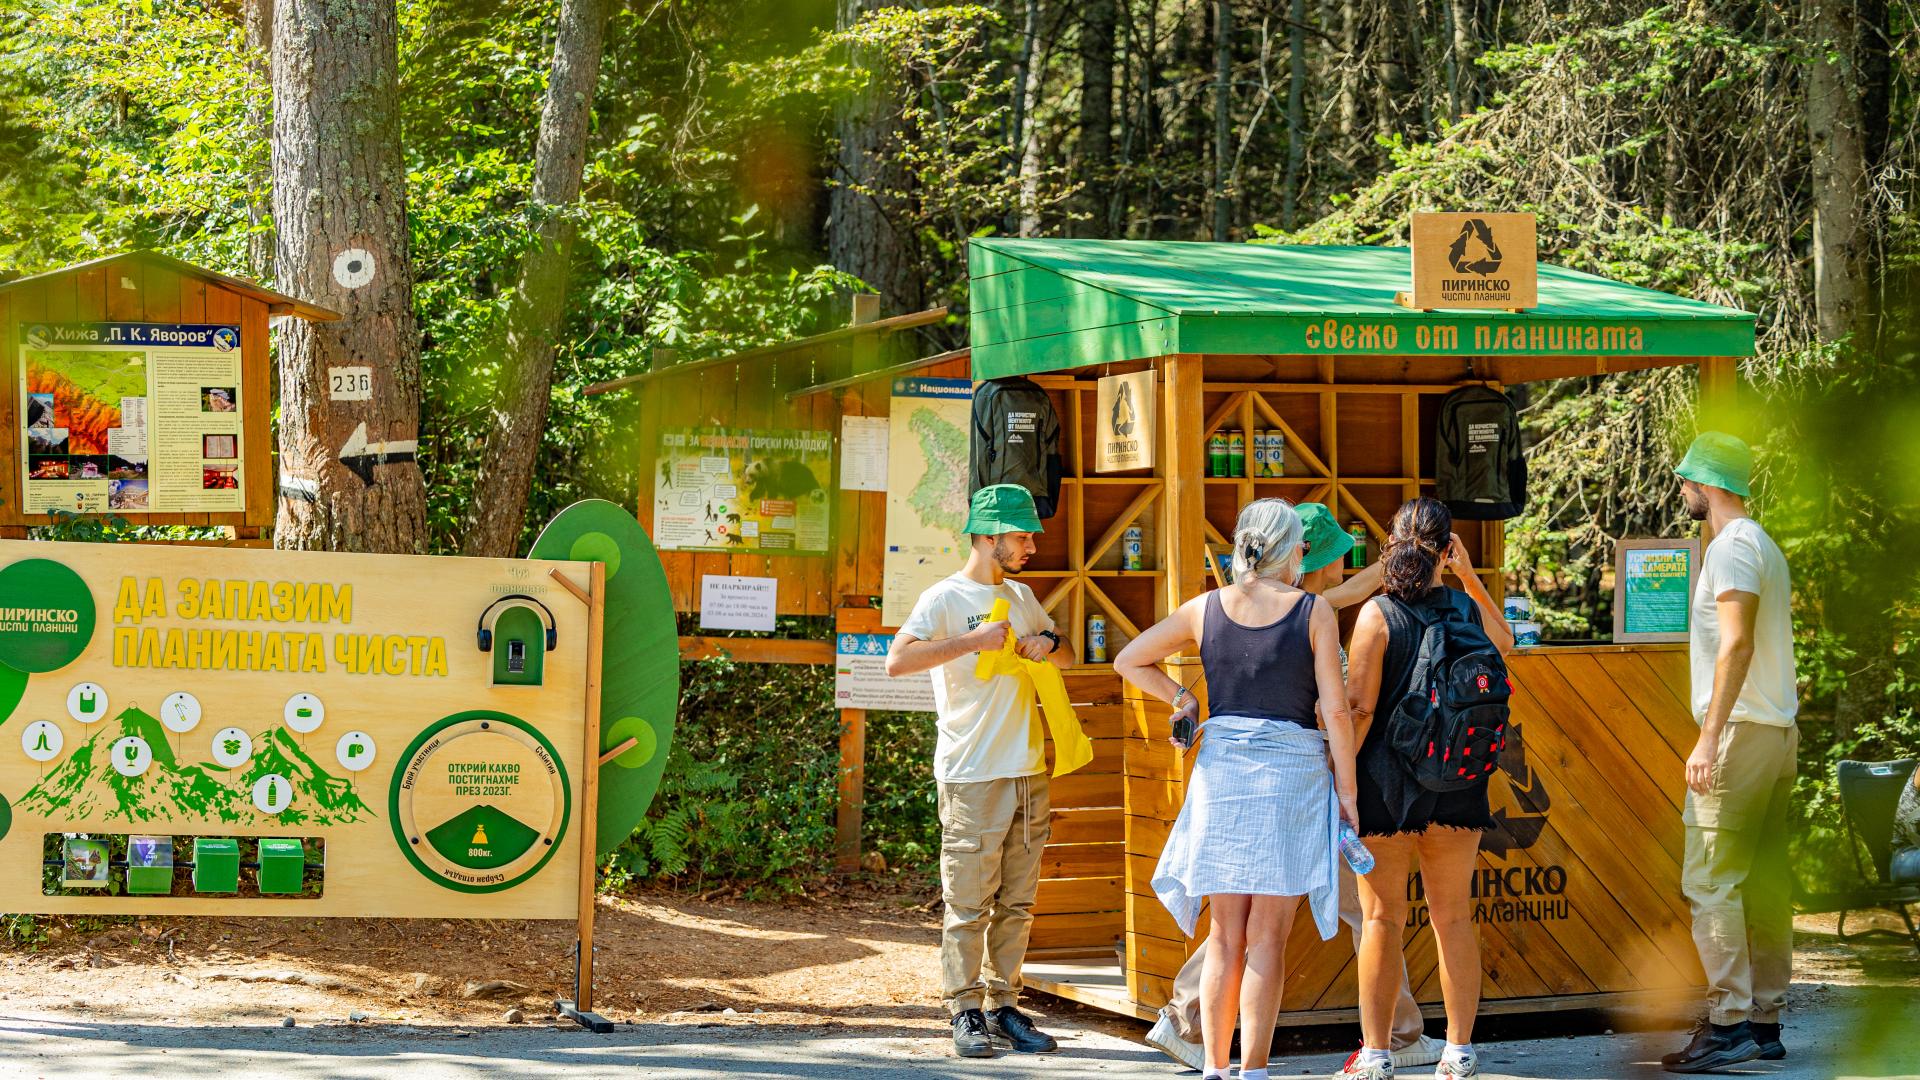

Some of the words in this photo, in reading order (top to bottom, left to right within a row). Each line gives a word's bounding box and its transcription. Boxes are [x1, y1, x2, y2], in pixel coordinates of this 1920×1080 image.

[1442, 280, 1510, 291] ПИРИНСКО
[1442, 292, 1470, 301] чисти
[1474, 292, 1510, 301] планини
[55, 327, 98, 340] Хижа
[130, 328, 146, 341] К.
[1306, 319, 1398, 350] свежо
[1415, 325, 1458, 350] от
[1475, 323, 1643, 351] планината
[333, 374, 369, 393] 236
[688, 436, 700, 447] ЗА
[750, 437, 781, 449] ГОРСКИ
[784, 438, 828, 452] РАЗХОДКИ
[1107, 440, 1138, 454] ПИРИНСКО
[113, 576, 166, 624] ДА
[176, 578, 353, 625] ЗАПАЗИМ
[968, 616, 975, 624] ДА
[32, 622, 78, 633] планини
[113, 627, 326, 673] ПЛАНИНАТА
[334, 634, 448, 676] ЧИСТА
[402, 769, 416, 790] Брой
[412, 738, 441, 773] участници
[535, 745, 556, 775] Събития
[448, 762, 488, 773] ОТКРИЙ
[489, 763, 520, 773] КАКВО
[448, 774, 520, 785] ПОСТИГНАХМЕ
[456, 786, 481, 796] ПРЕЗ
[483, 786, 512, 796] 2023Г.
[468, 848, 493, 857] 800кг.
[444, 868, 475, 883] отпадък
[476, 873, 505, 883] Събран
[1475, 899, 1568, 923] планини
